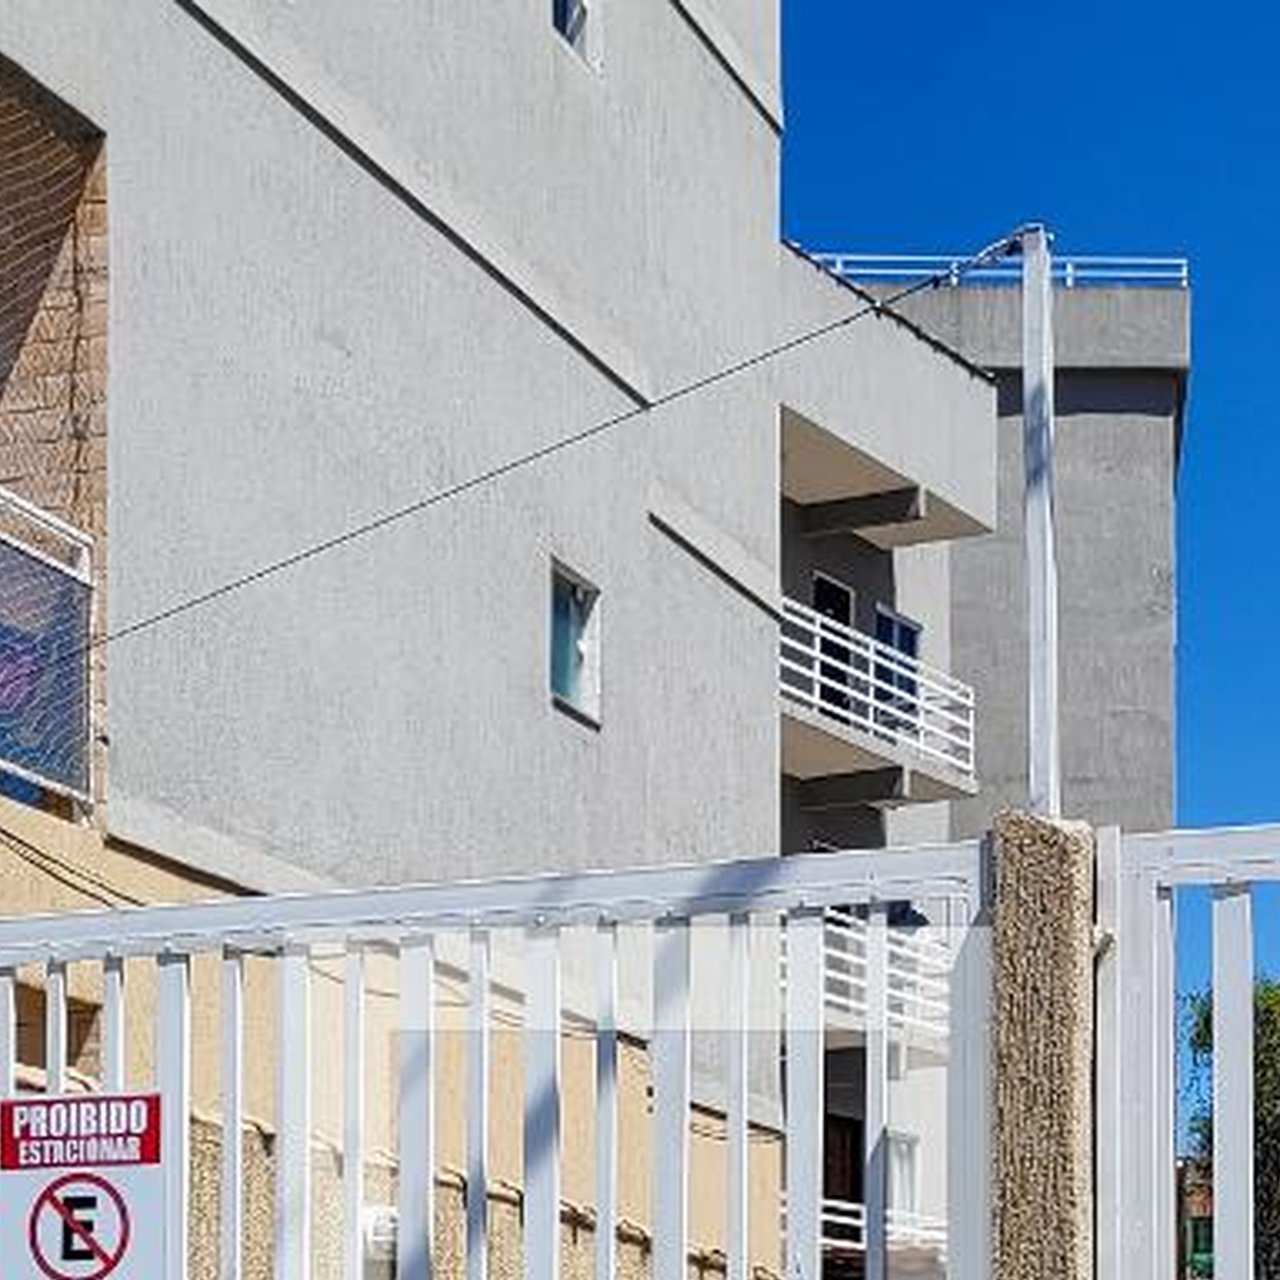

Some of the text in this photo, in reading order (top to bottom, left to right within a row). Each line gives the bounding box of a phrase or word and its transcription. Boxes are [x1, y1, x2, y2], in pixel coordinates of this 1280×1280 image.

[13, 1099, 149, 1138] PROIBIDO
[18, 1137, 142, 1166] ESTACIONAR
[61, 1196, 98, 1261] E
